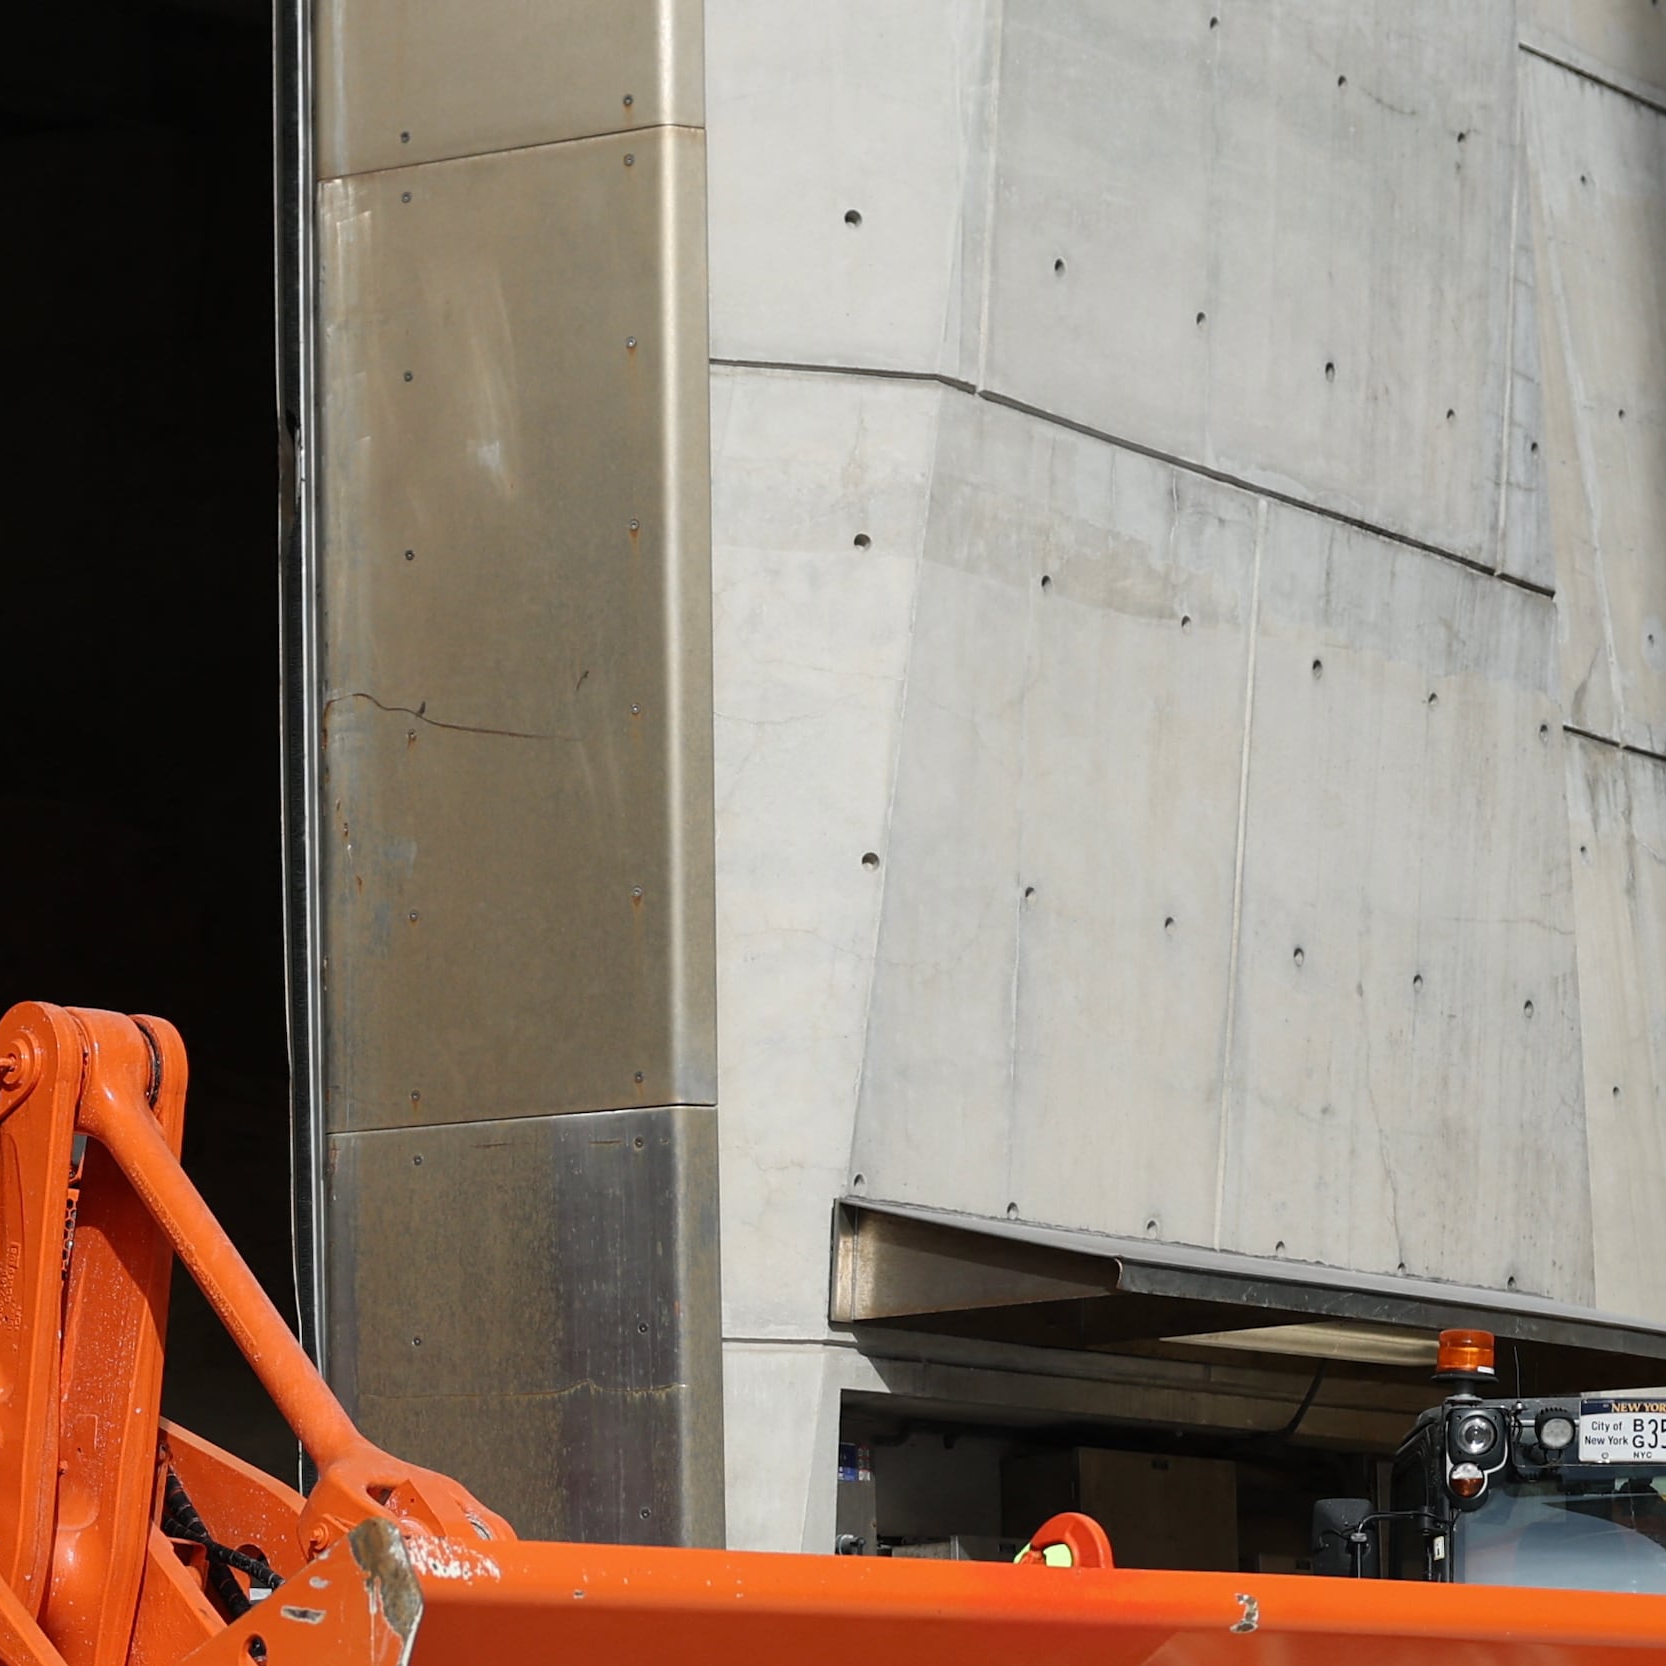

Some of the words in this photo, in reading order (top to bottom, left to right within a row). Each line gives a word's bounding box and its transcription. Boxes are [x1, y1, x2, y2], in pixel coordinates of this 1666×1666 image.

[1612, 1403, 1640, 1413] NEW
[1591, 1421, 1610, 1432] City
[1613, 1421, 1622, 1431] of
[1584, 1436, 1605, 1445] New
[1608, 1436, 1629, 1445] York
